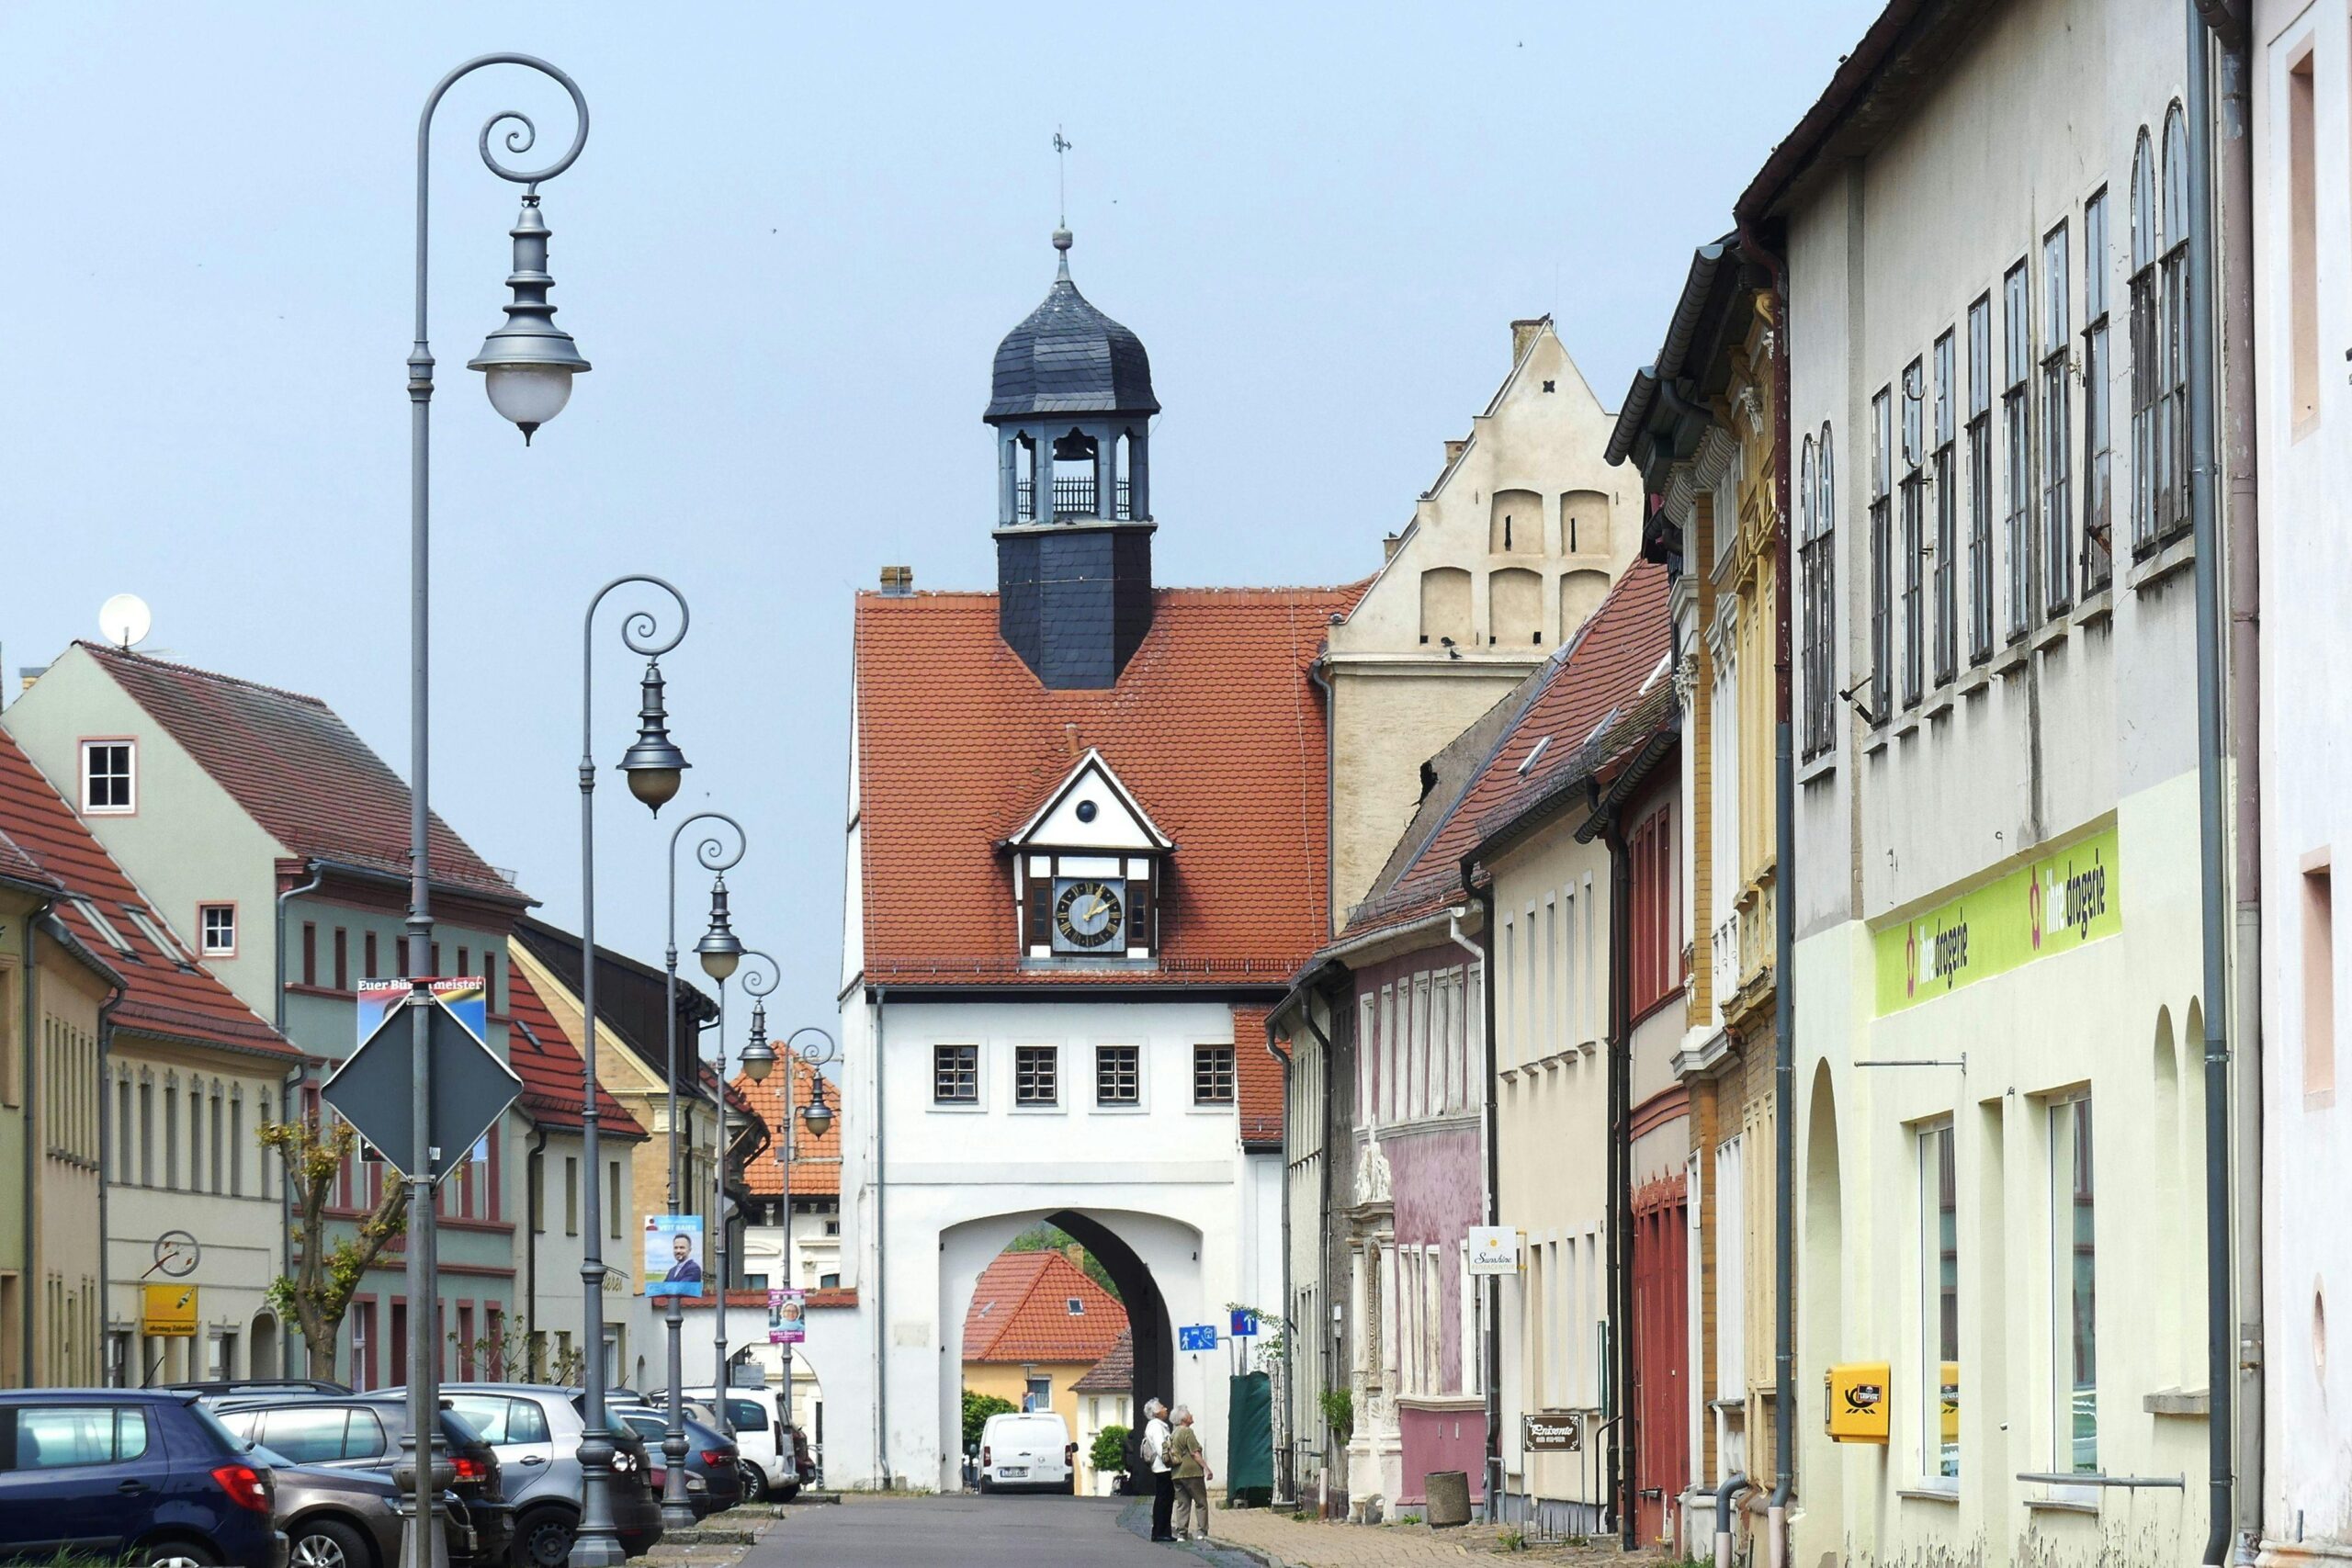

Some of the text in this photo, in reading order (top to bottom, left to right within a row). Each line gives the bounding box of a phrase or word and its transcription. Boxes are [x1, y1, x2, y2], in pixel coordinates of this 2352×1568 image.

[2066, 848, 2105, 940] drogerie
[1935, 907, 1968, 989] drogerie
[358, 976, 482, 991] Euer Bürmeister
[1475, 1252, 1512, 1265] Sunshine
[1530, 1424, 1574, 1436] Präsente
